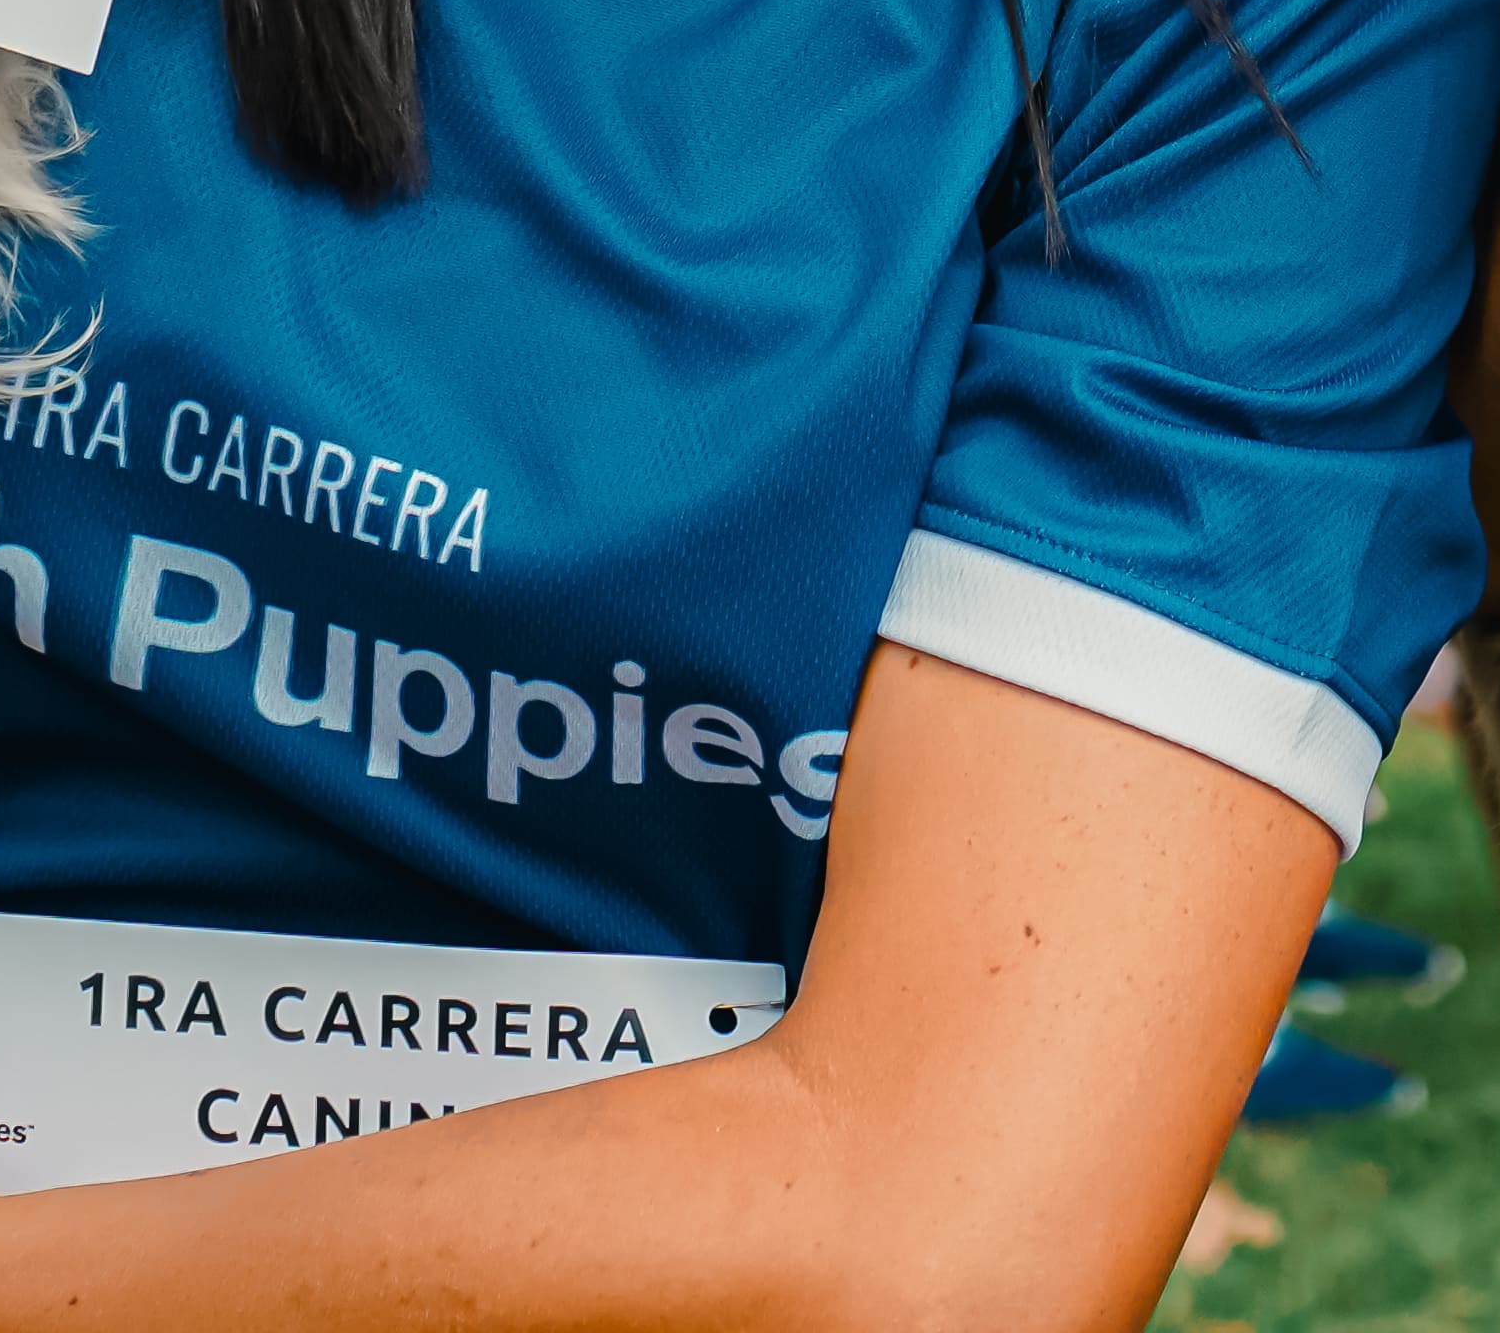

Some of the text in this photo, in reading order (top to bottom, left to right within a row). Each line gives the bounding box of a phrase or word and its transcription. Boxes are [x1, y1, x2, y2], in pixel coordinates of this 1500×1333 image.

[162, 399, 489, 574] CARRERA
[110, 533, 849, 841] Puppies
[80, 971, 654, 1065] 1RA CARRERA
